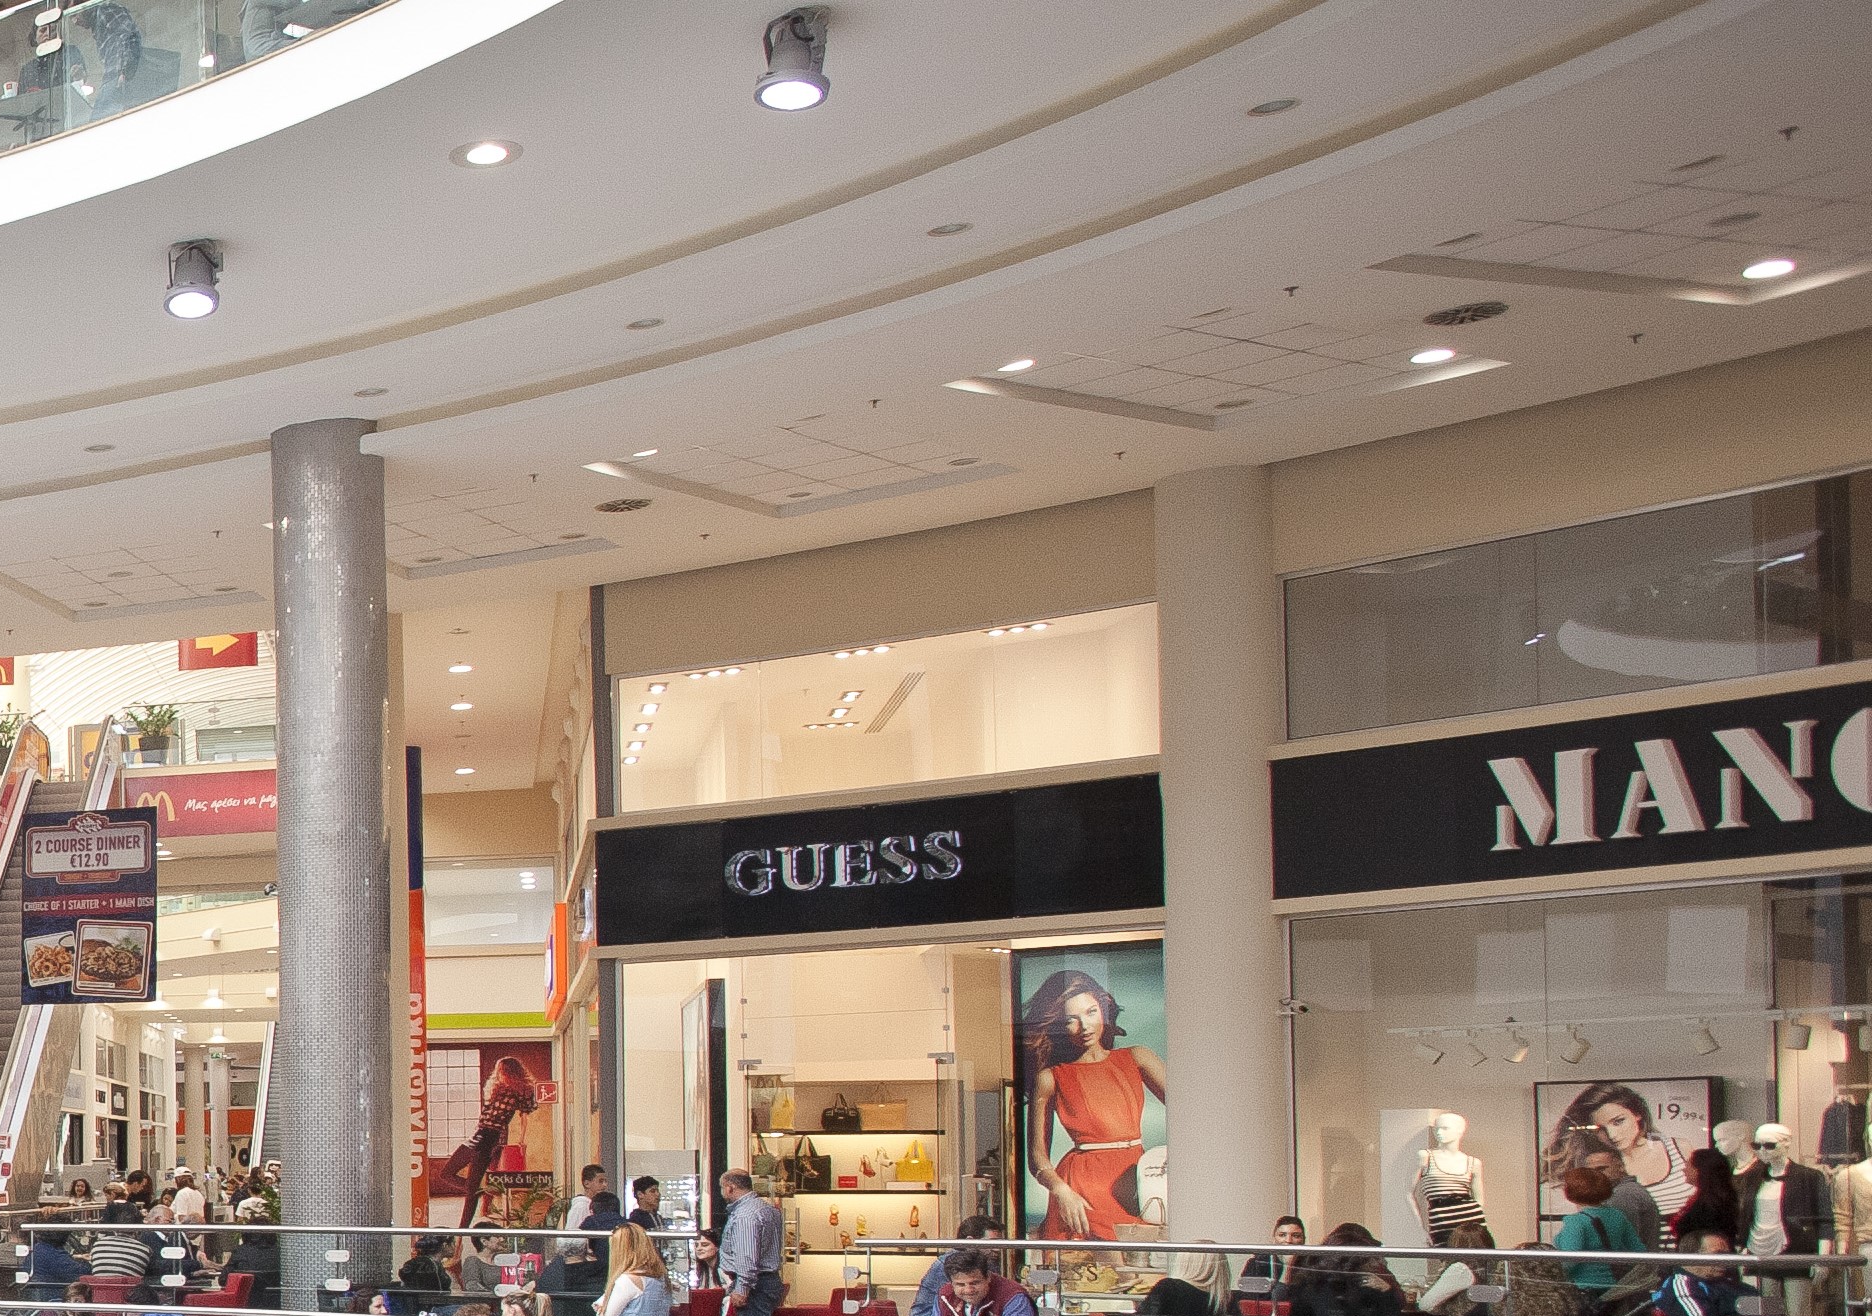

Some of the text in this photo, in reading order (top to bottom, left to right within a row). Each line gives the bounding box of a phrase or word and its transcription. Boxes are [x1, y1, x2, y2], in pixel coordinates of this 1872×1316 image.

[35, 834, 141, 854] 2 COURSE DINNER
[70, 853, 109, 868] €12.90
[724, 830, 963, 896] GUESS
[23, 902, 49, 912] CHOICE
[68, 900, 100, 910] STARTER
[115, 898, 136, 908] MAIN
[137, 897, 154, 907] DISH
[488, 1172, 553, 1187] Socks & tights
